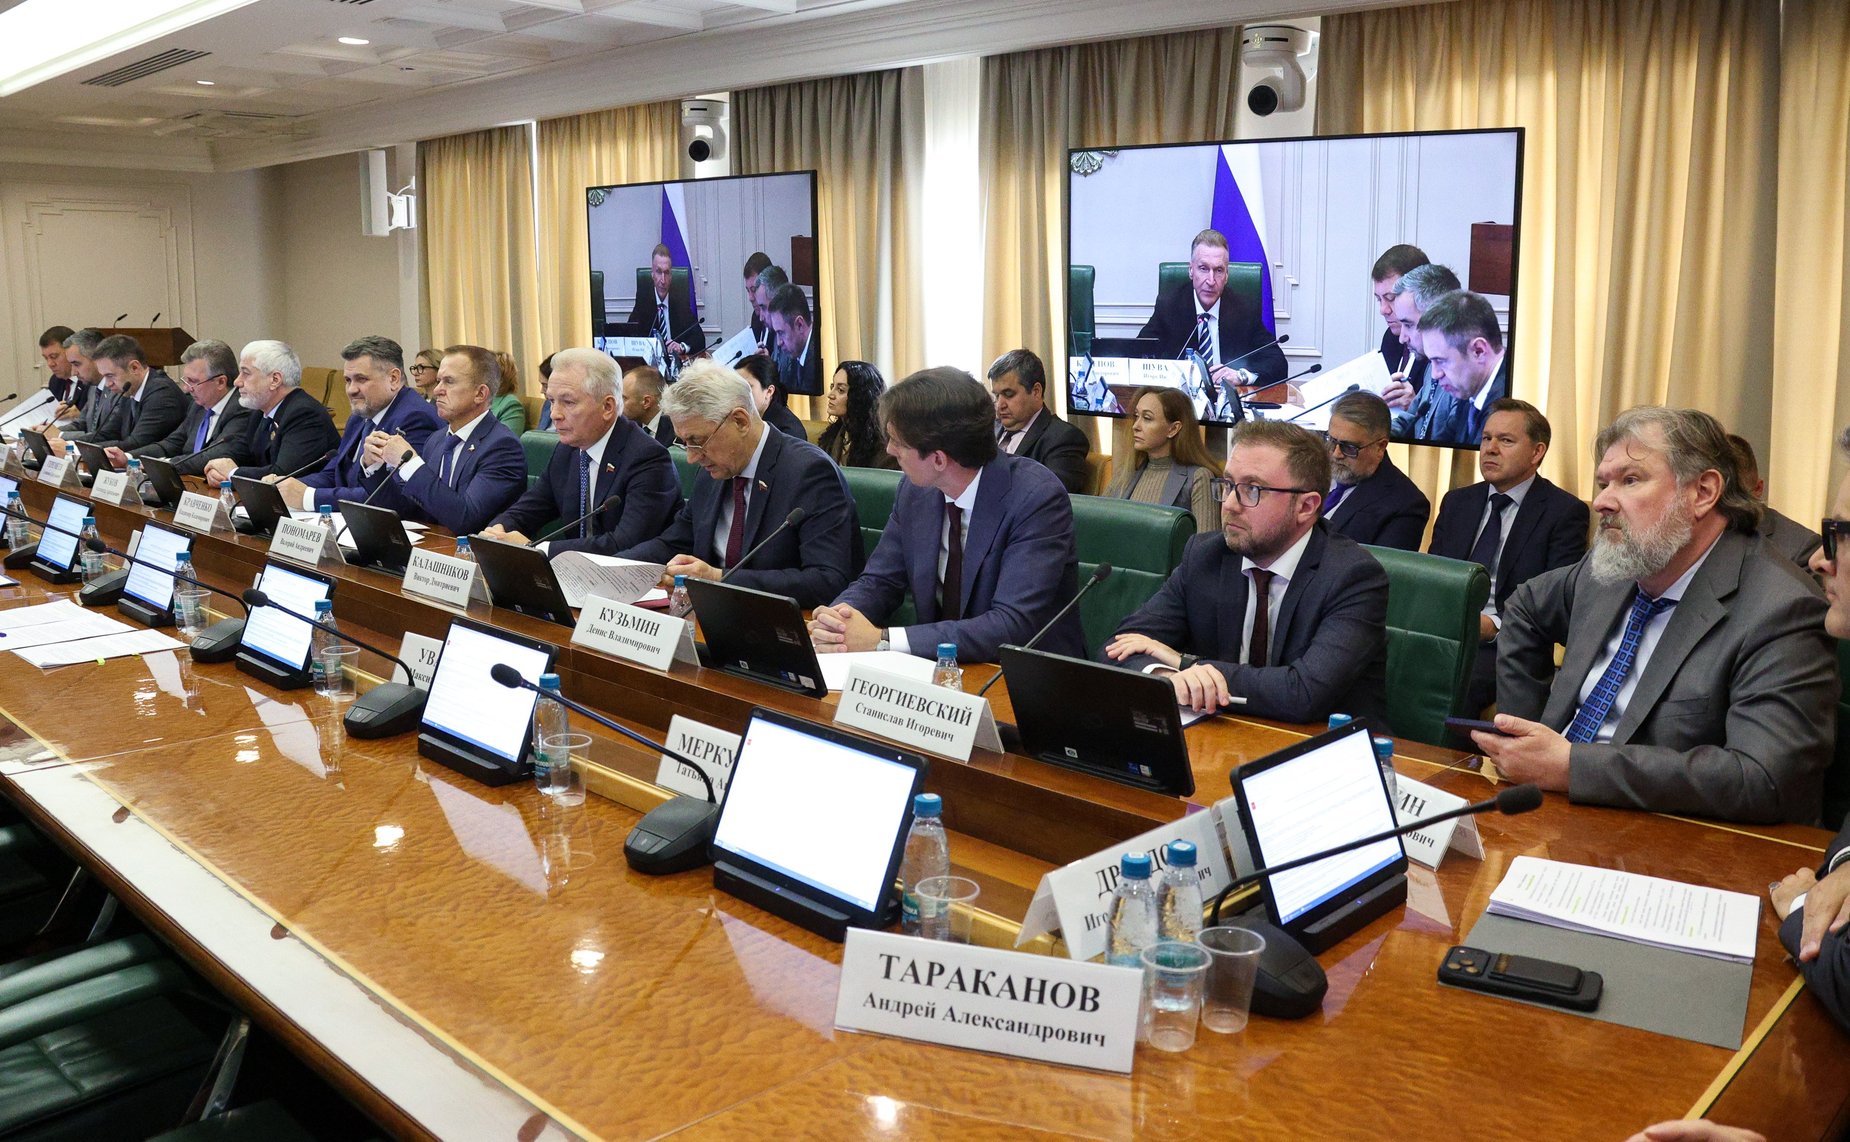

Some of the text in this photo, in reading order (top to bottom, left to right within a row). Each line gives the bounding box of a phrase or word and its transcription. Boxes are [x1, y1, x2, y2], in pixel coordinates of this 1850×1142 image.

[183, 496, 213, 513] КРАВЧЕНКО
[281, 523, 322, 543] ПОНОМАРЕВ
[412, 555, 470, 581] КАЛАШНИКОВ
[412, 571, 460, 593] Виктор Дмитриевич
[599, 606, 661, 637] КУЗЬМИН
[586, 623, 661, 655] Денис Владимирович
[418, 647, 437, 667] УВ
[409, 667, 431, 683] Макси
[850, 677, 973, 727] ГЕОРГИЕВСКИЙ
[855, 702, 954, 742] Станислав Игоревич
[677, 732, 736, 768] МЕРКУ
[879, 953, 1101, 1013] ТАРАКАНОВ
[863, 991, 1107, 1047] Андрей Александрович
